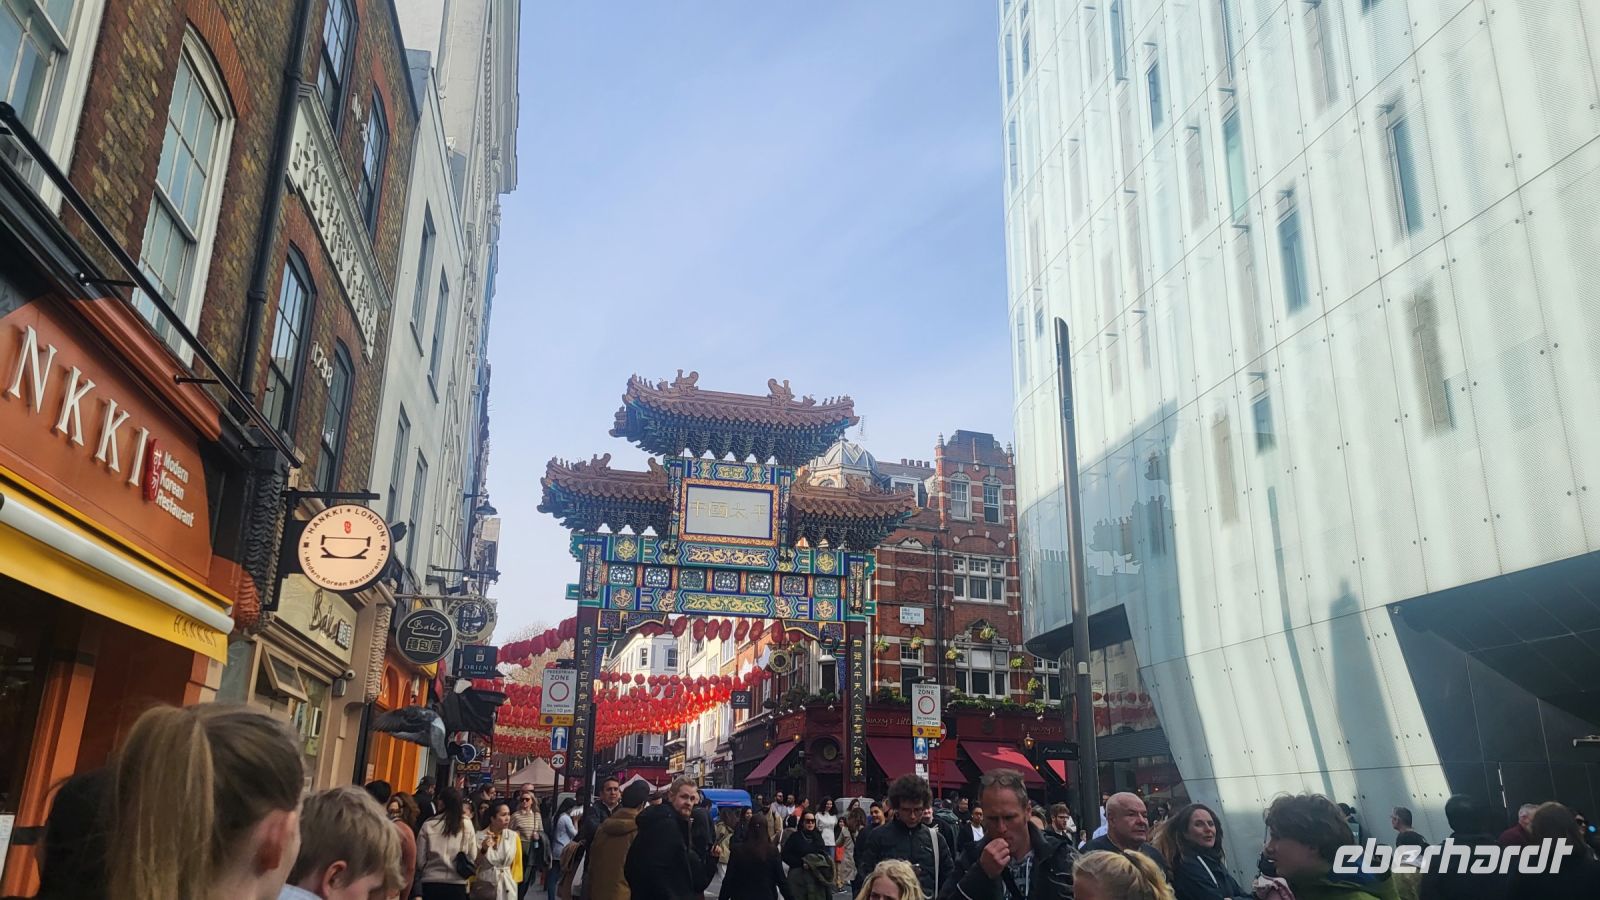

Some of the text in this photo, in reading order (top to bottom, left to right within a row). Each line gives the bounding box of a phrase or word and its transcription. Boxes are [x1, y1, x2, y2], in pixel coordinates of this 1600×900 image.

[311, 341, 333, 387] 1798
[8, 325, 150, 486] NKKI
[163, 451, 189, 484] Modern
[160, 469, 185, 500] Korean
[155, 488, 194, 528] Restaurant
[307, 508, 343, 535] HANKKI
[354, 508, 386, 538] LONDON
[304, 556, 383, 587] Modern Korean Restaurant
[736, 695, 746, 703] 22
[553, 757, 564, 765] 20
